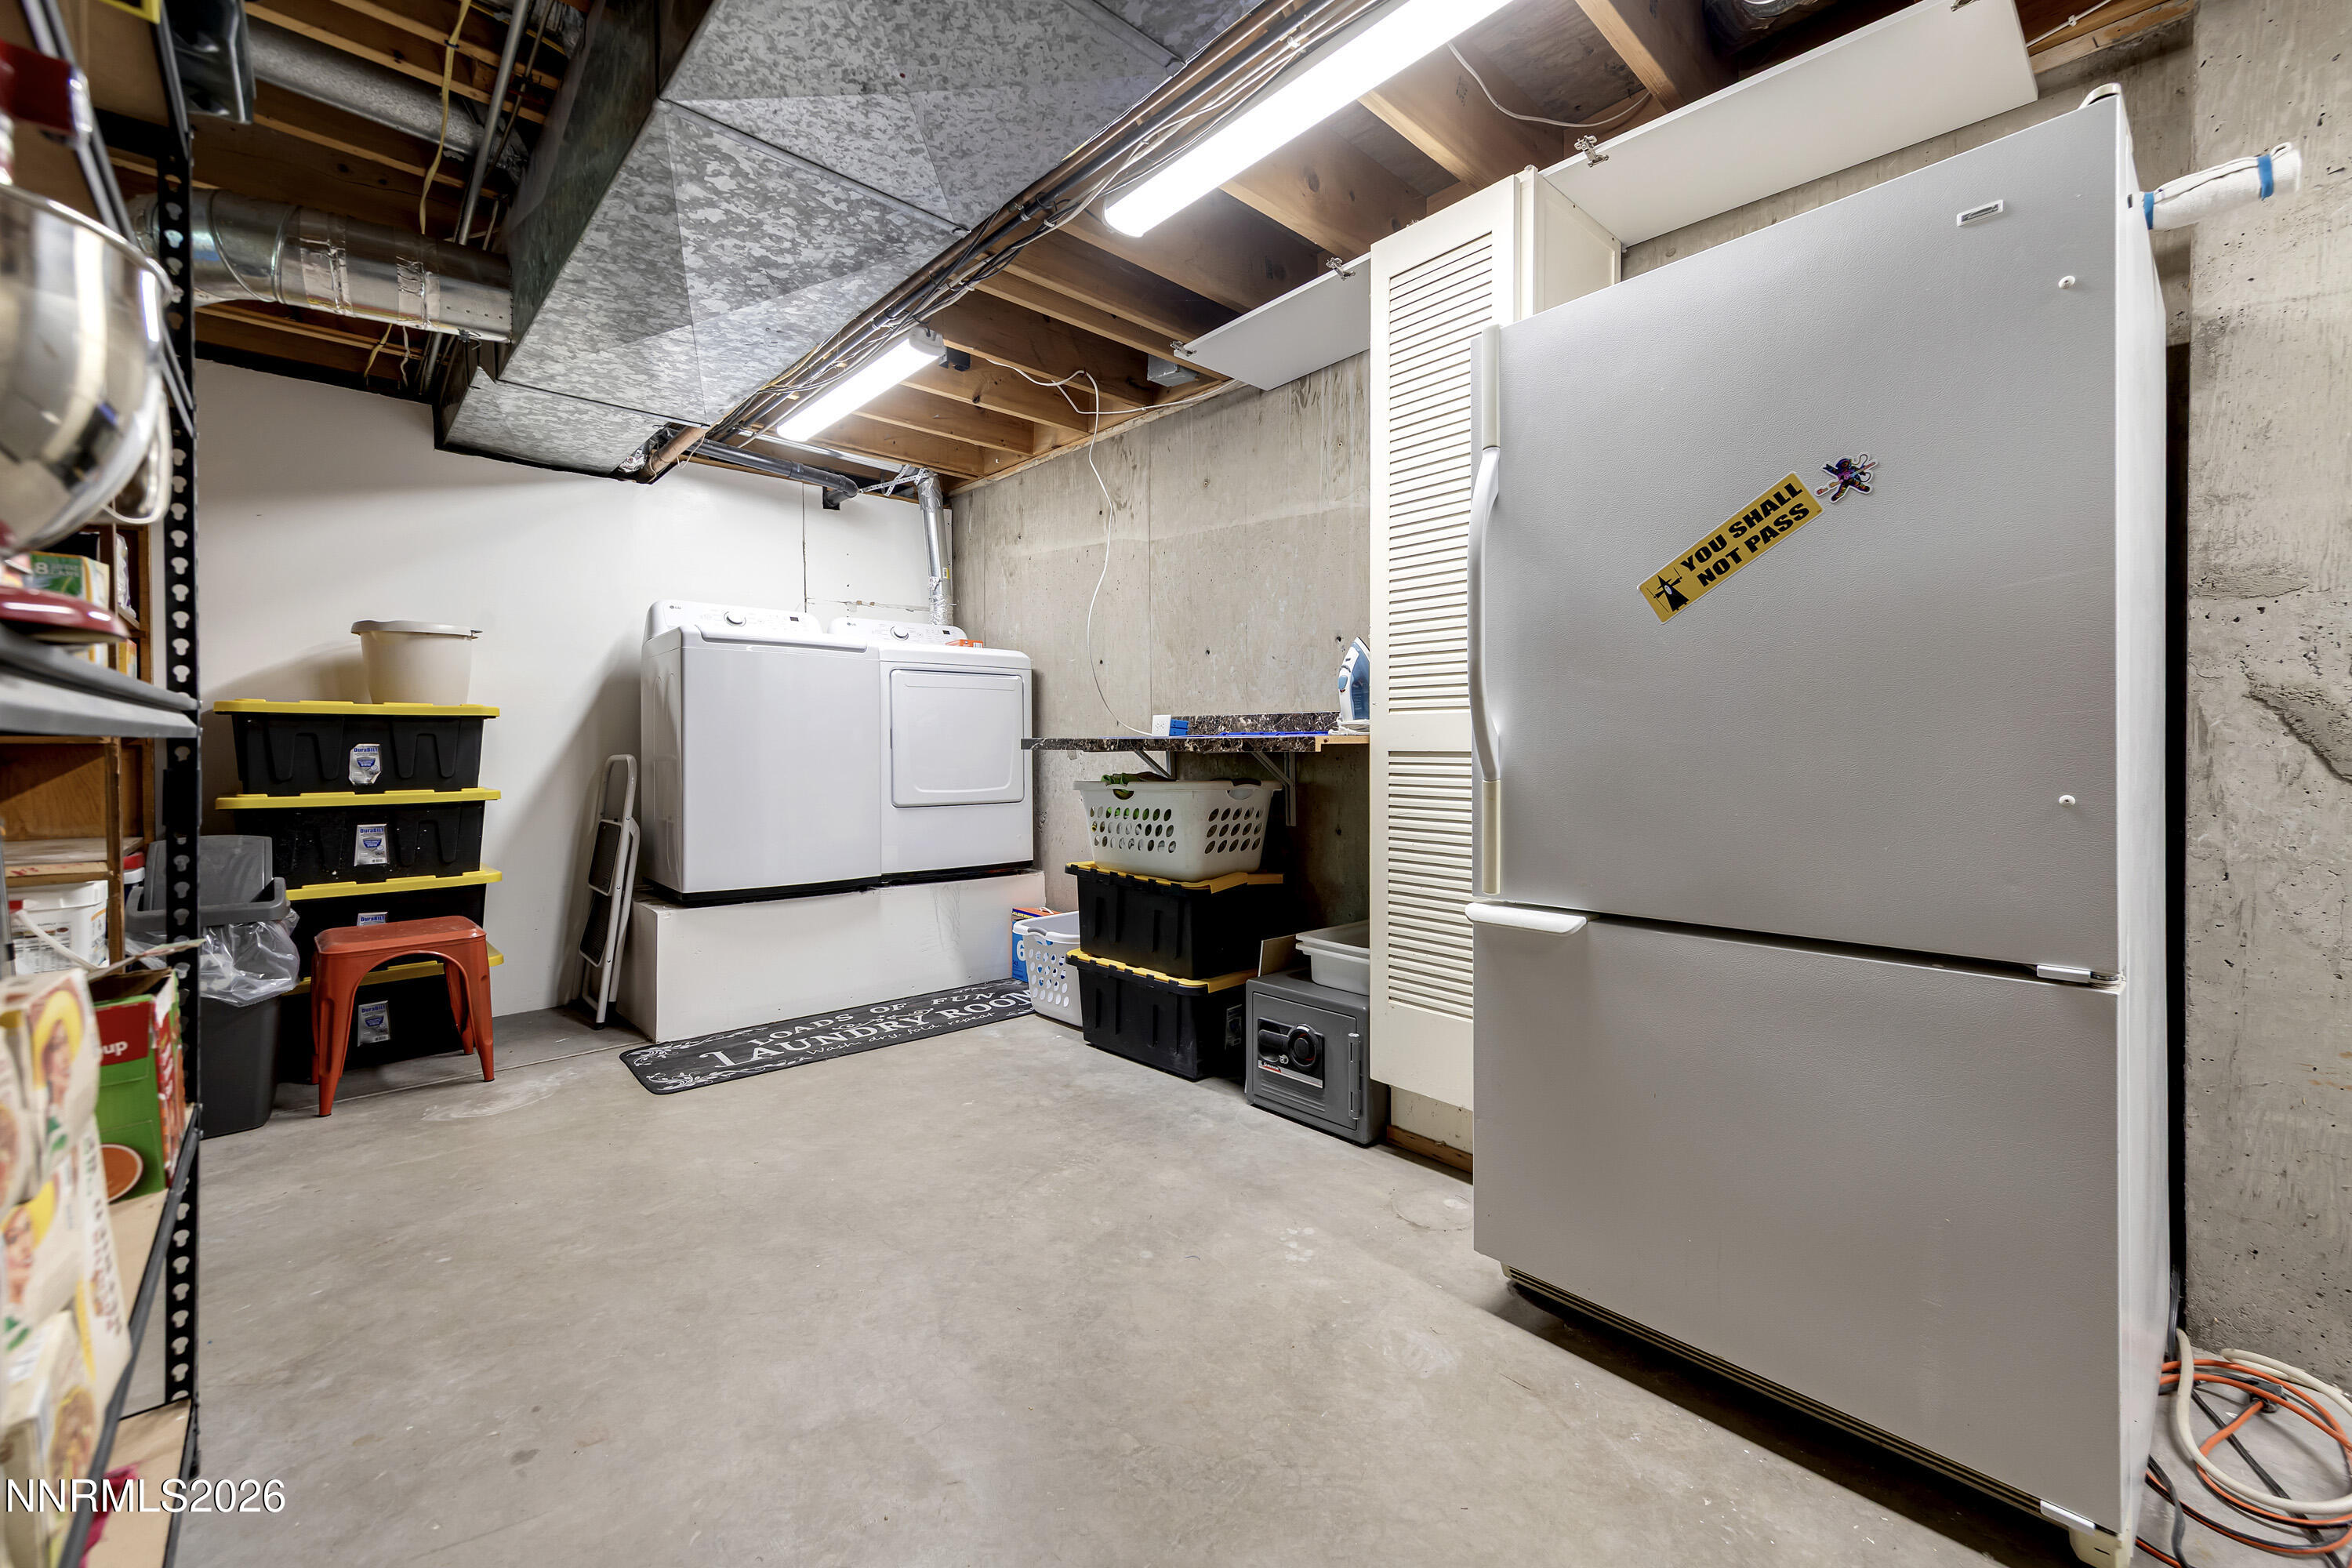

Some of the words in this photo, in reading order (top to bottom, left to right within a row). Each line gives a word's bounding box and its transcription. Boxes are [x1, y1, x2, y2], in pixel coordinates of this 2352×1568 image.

[1680, 534, 1727, 572] YOU
[1728, 482, 1803, 539] SHALL
[1697, 546, 1743, 587] NOT
[1744, 503, 1809, 554] PASS
[699, 1014, 929, 1068] LAUNDRY
[748, 1013, 854, 1047] LOADS
[869, 1003, 907, 1014] OF
[931, 992, 996, 1005] FUN
[948, 1012, 995, 1025] repeat
